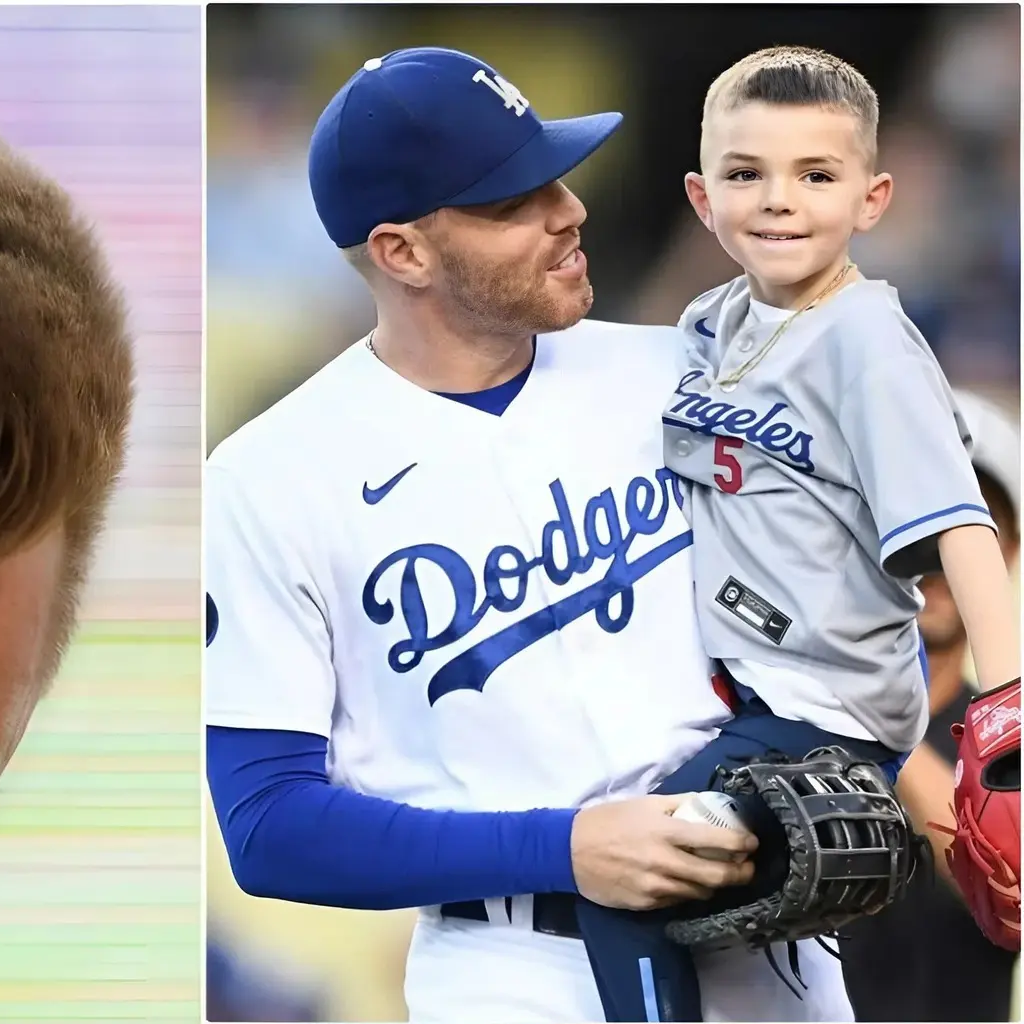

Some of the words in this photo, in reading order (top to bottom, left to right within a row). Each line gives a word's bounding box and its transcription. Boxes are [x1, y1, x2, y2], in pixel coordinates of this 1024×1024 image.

[472, 69, 529, 117] LA
[713, 436, 745, 494] 5
[363, 466, 685, 673] Dodger
